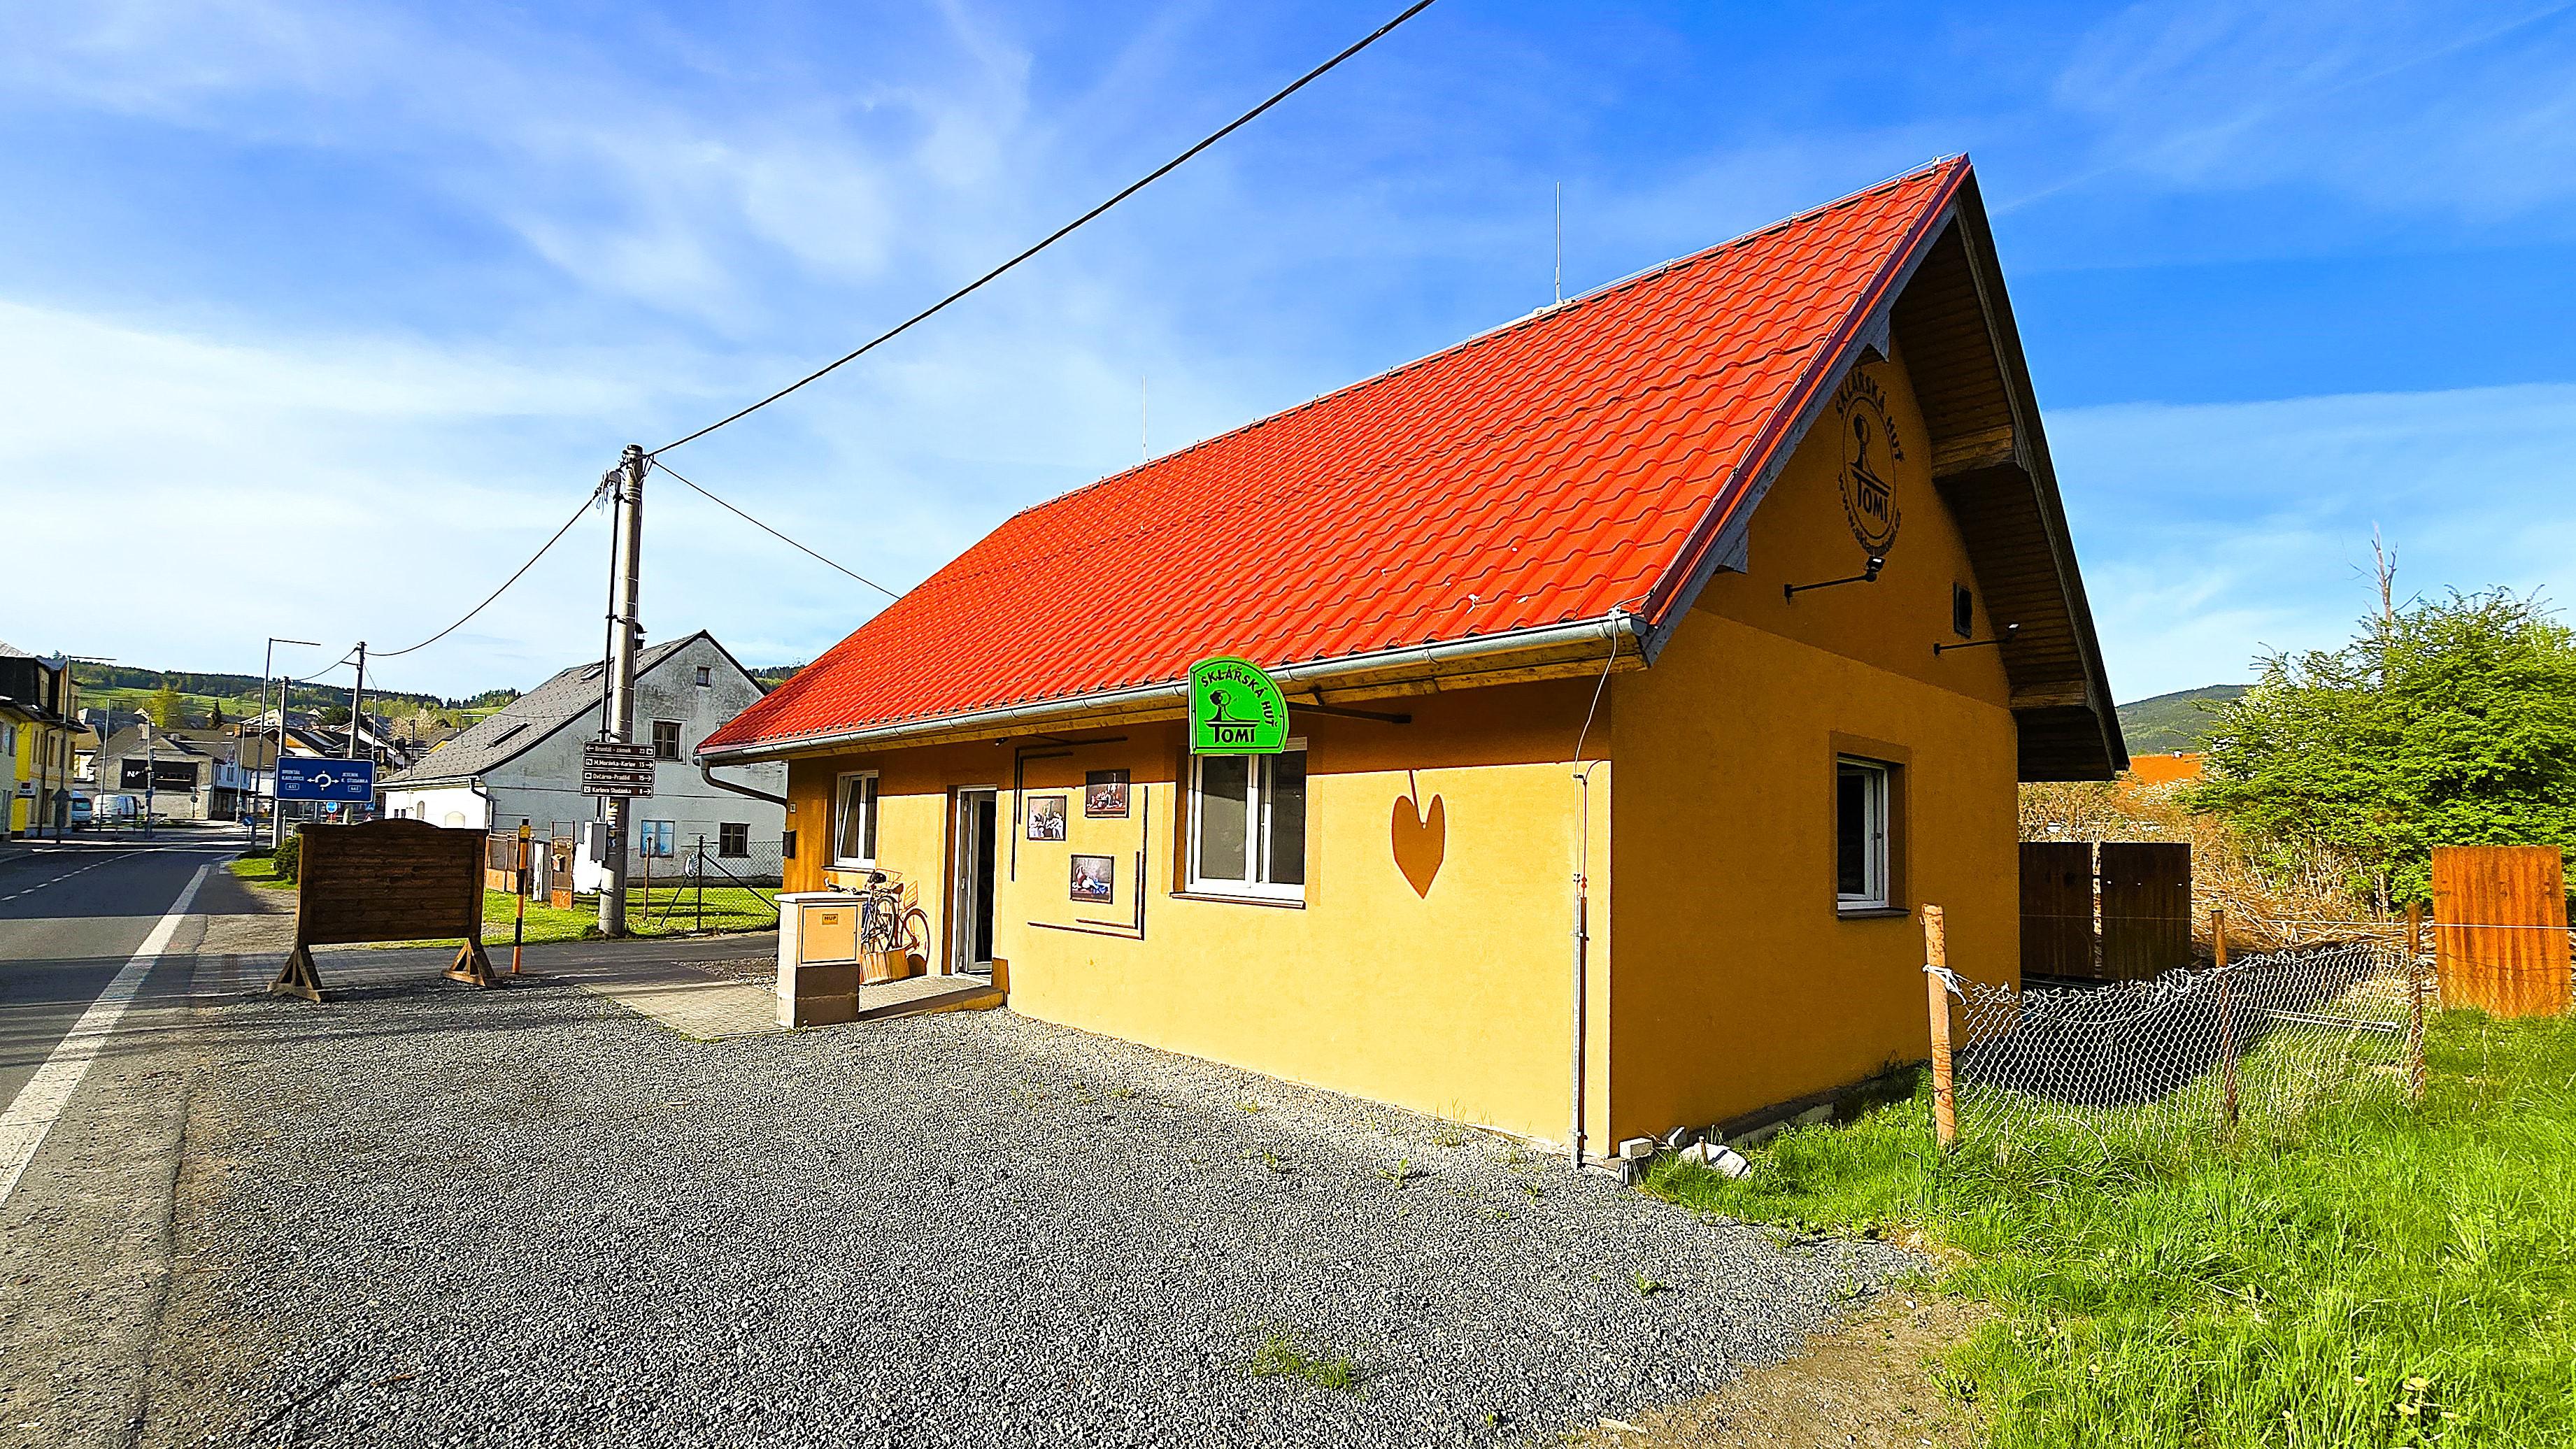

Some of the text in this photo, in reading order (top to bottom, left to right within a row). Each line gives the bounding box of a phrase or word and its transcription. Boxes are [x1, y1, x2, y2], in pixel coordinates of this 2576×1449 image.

[1855, 478, 1888, 524] TOMI
[1201, 664, 1279, 728] SKLÁŘSKÁ HUŤ
[1211, 724, 1255, 743] TOMI
